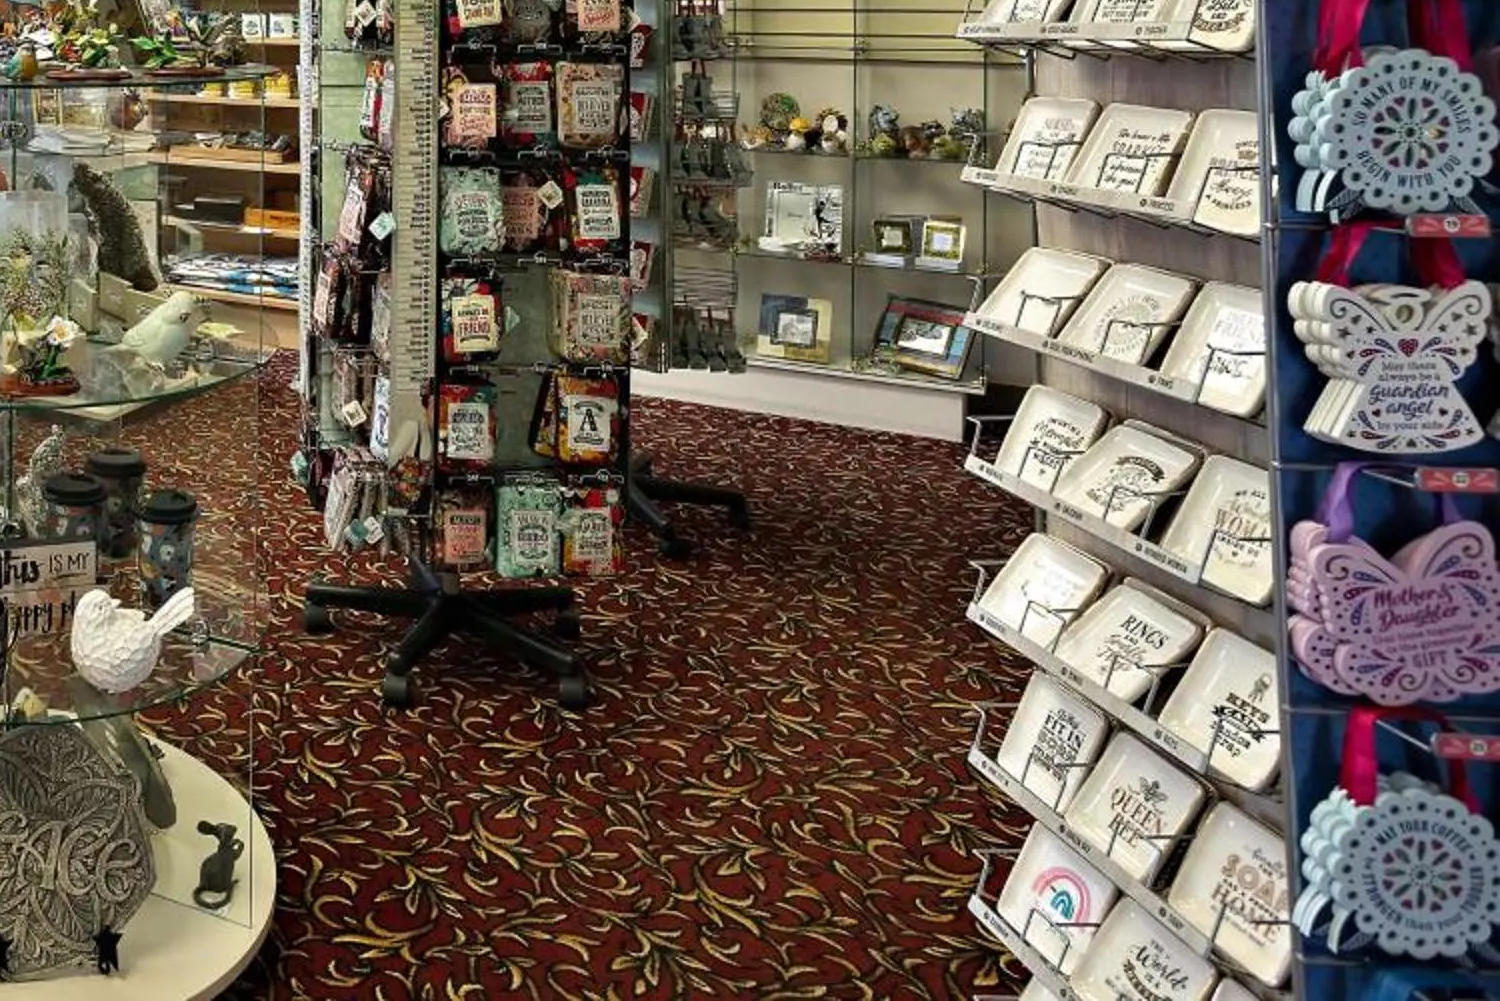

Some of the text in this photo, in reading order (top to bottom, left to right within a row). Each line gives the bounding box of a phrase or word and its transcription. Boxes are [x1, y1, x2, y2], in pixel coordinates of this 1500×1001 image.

[1352, 76, 1472, 134] SO MANY OF MY SMILES
[1355, 150, 1462, 189] BEGIN WITH YOU
[1369, 382, 1450, 406] guardian
[1385, 399, 1434, 421] angel
[50, 554, 64, 574] IS
[67, 552, 91, 571] MY
[1120, 615, 1169, 650] RINGS
[1378, 604, 1461, 632] Daughter
[1226, 692, 1270, 724] KEYS
[1110, 788, 1162, 834] QUEEN
[1108, 813, 1145, 848] BEE
[1399, 820, 1430, 833] YOUR
[1431, 822, 1472, 854] COFFEE
[1361, 872, 1405, 925] STRONGER
[1135, 945, 1189, 990] World
